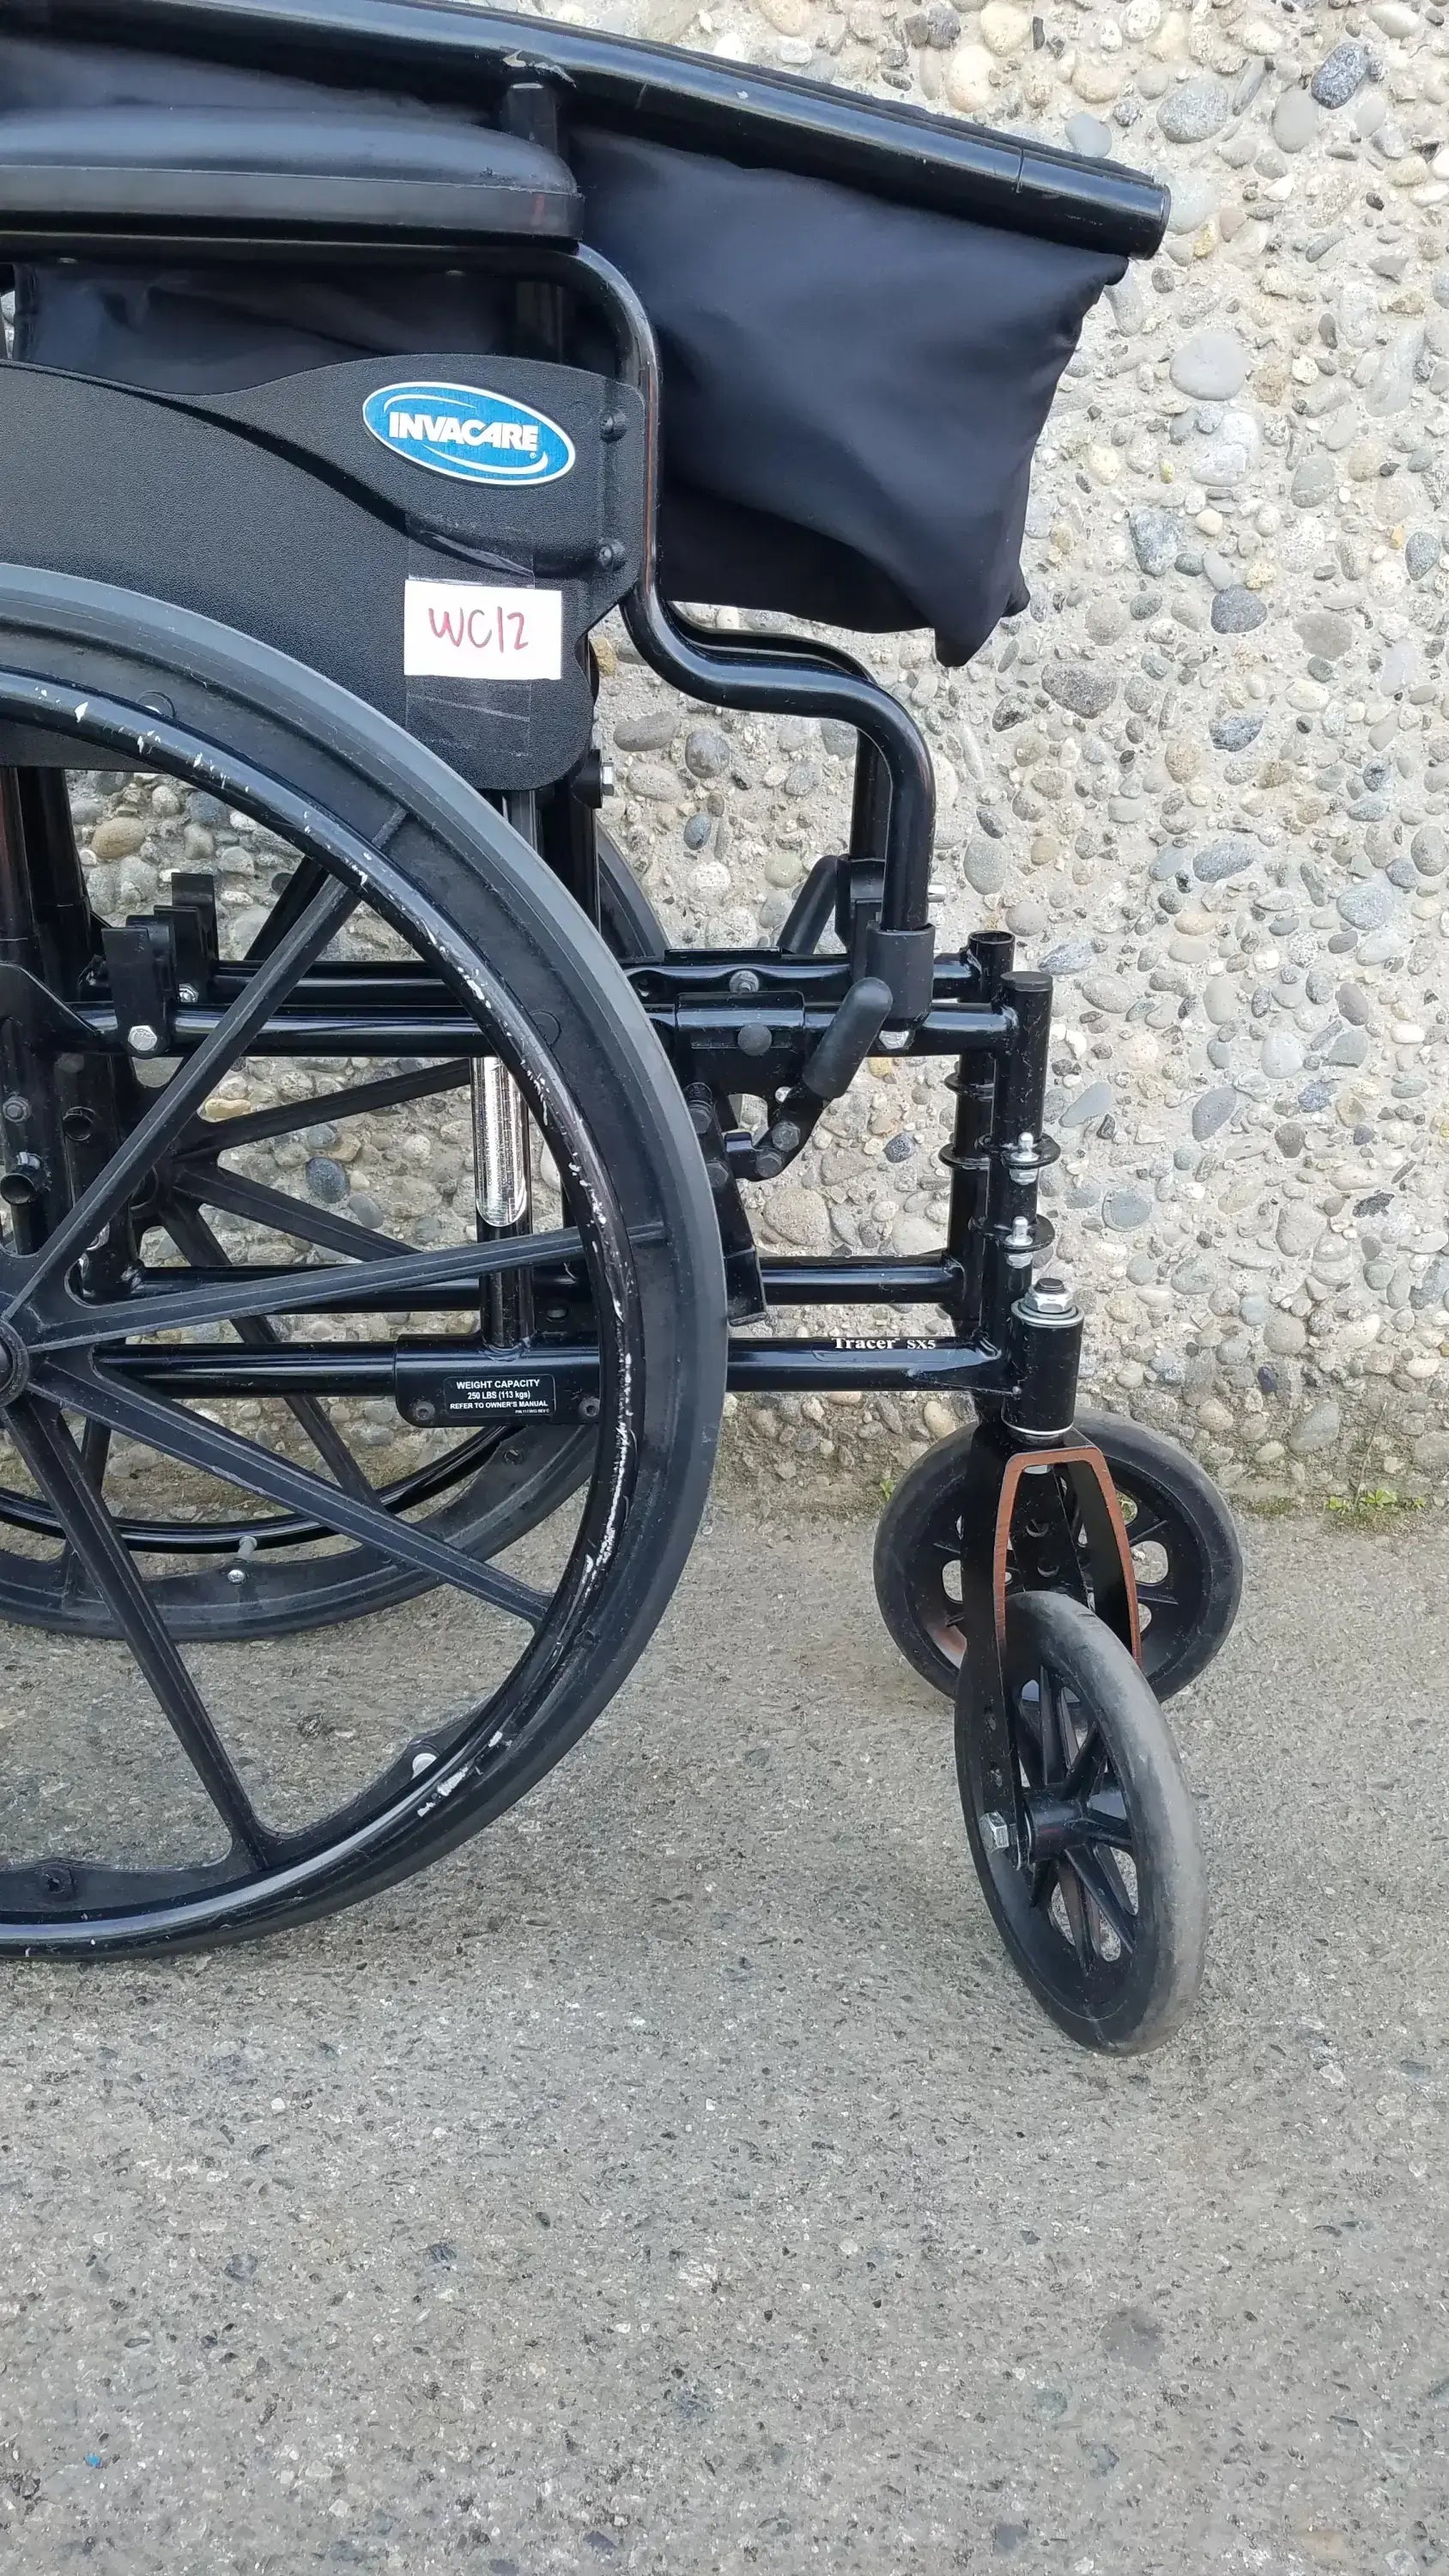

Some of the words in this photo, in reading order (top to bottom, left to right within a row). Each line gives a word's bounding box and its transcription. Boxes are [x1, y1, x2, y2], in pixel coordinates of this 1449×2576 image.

[388, 411, 539, 453] INVACARE
[428, 605, 530, 653] WC12
[831, 1337, 894, 1350] Tracer
[906, 1339, 937, 1350] SX5
[457, 1381, 492, 1389] WEIGHT
[494, 1379, 540, 1388] CAPACITY
[482, 1391, 497, 1400] LBS
[498, 1391, 513, 1400] (113
[515, 1390, 530, 1400] kgs)
[485, 1400, 518, 1409] OWNER'S
